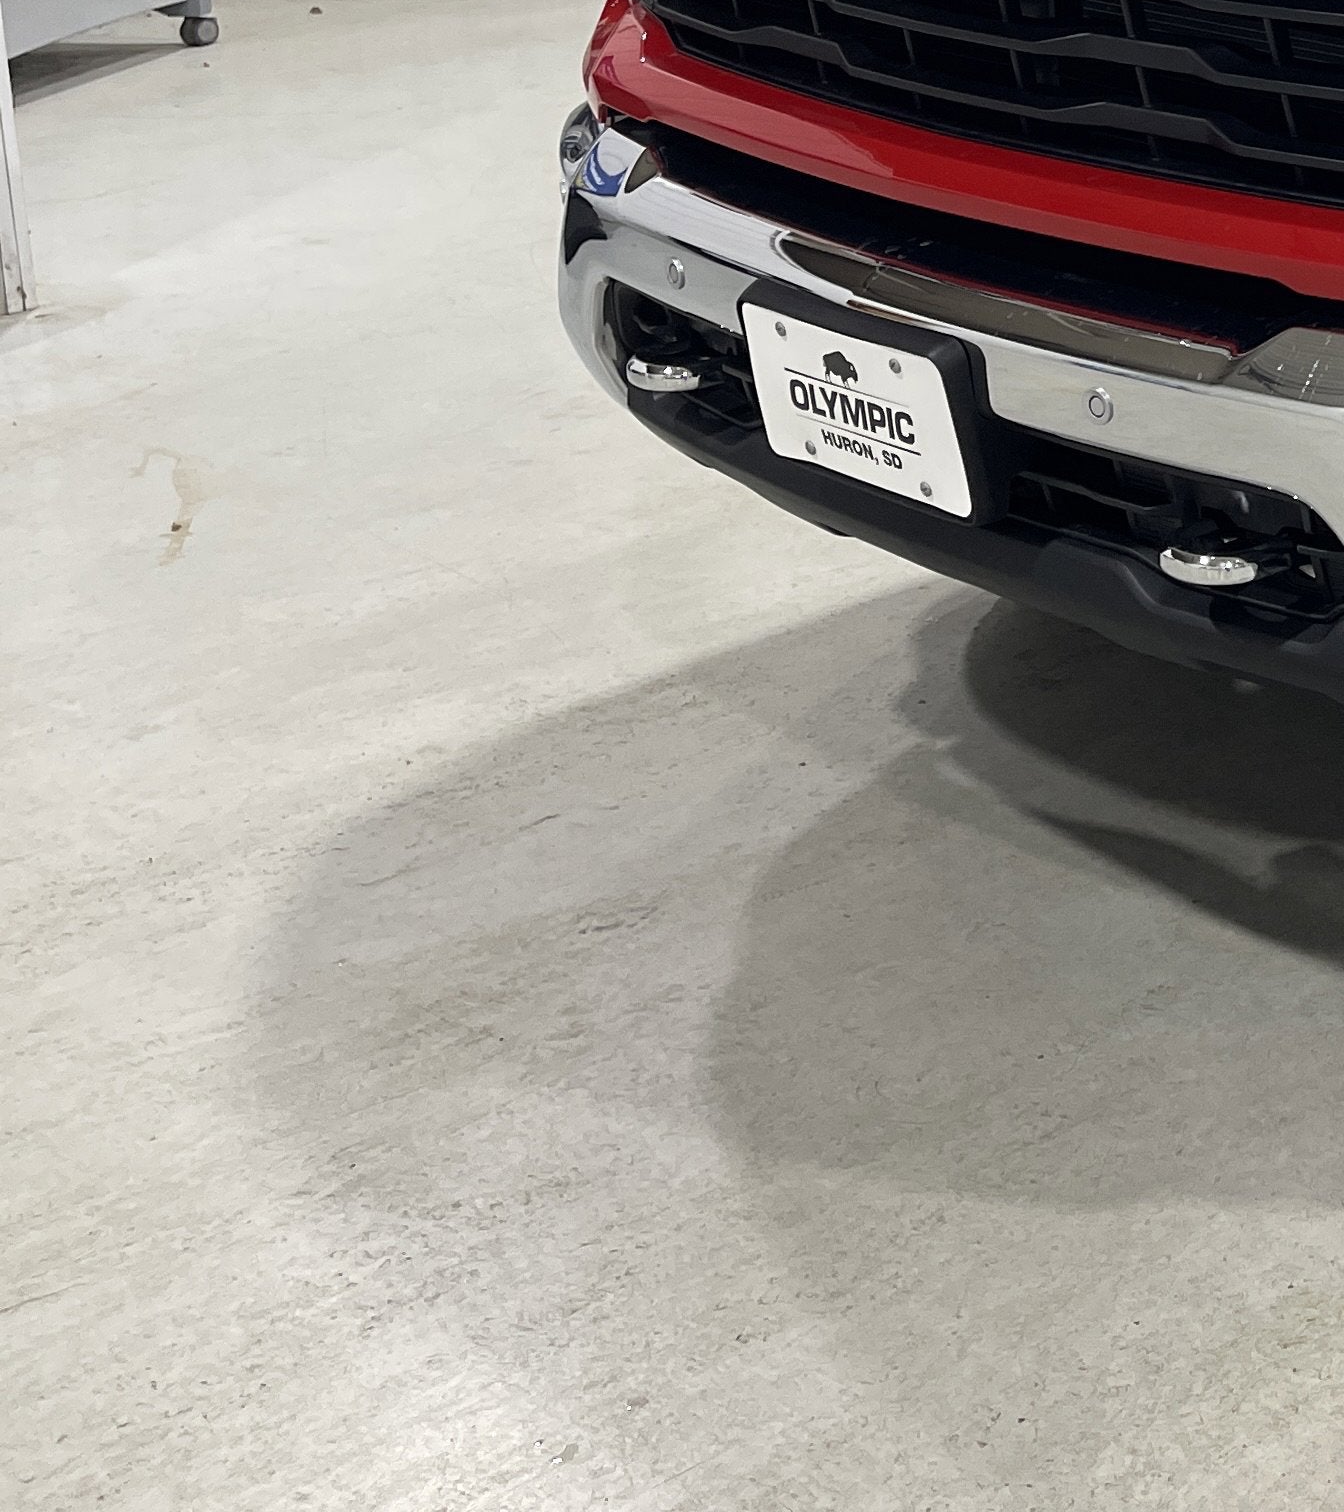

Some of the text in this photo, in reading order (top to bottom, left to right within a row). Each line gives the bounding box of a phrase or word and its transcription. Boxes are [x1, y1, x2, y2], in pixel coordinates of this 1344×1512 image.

[789, 378, 916, 446] OLYMPIC
[820, 429, 903, 470] HURON, SD
